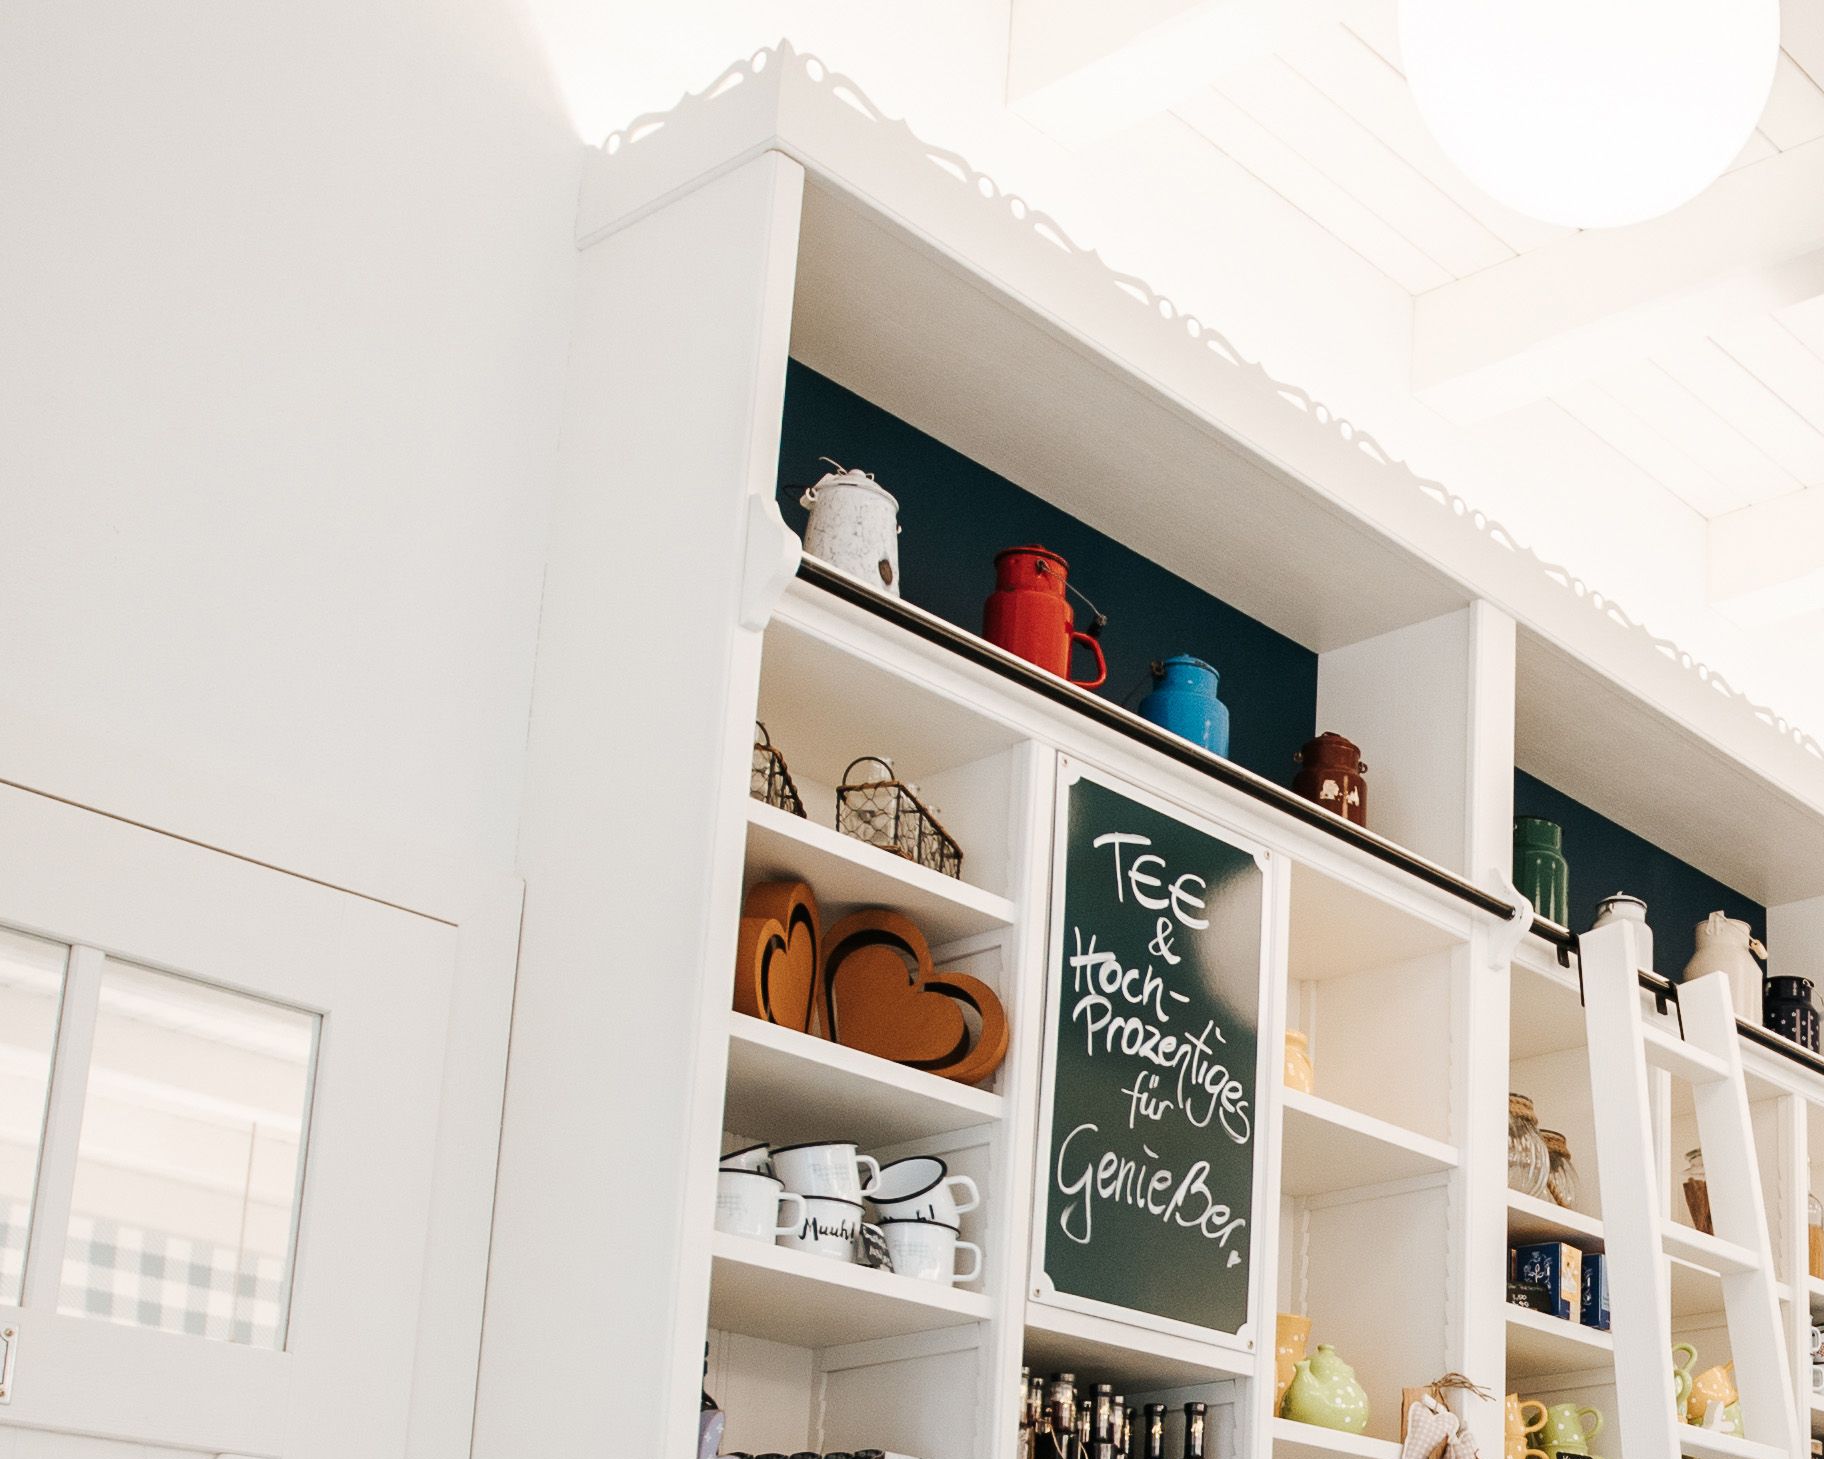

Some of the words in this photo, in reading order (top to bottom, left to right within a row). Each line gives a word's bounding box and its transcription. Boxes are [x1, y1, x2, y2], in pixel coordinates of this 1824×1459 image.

[1094, 832, 1209, 930] TEE
[1148, 916, 1180, 964] &
[1121, 1070, 1174, 1128] für
[797, 1217, 855, 1244] Muuh!
